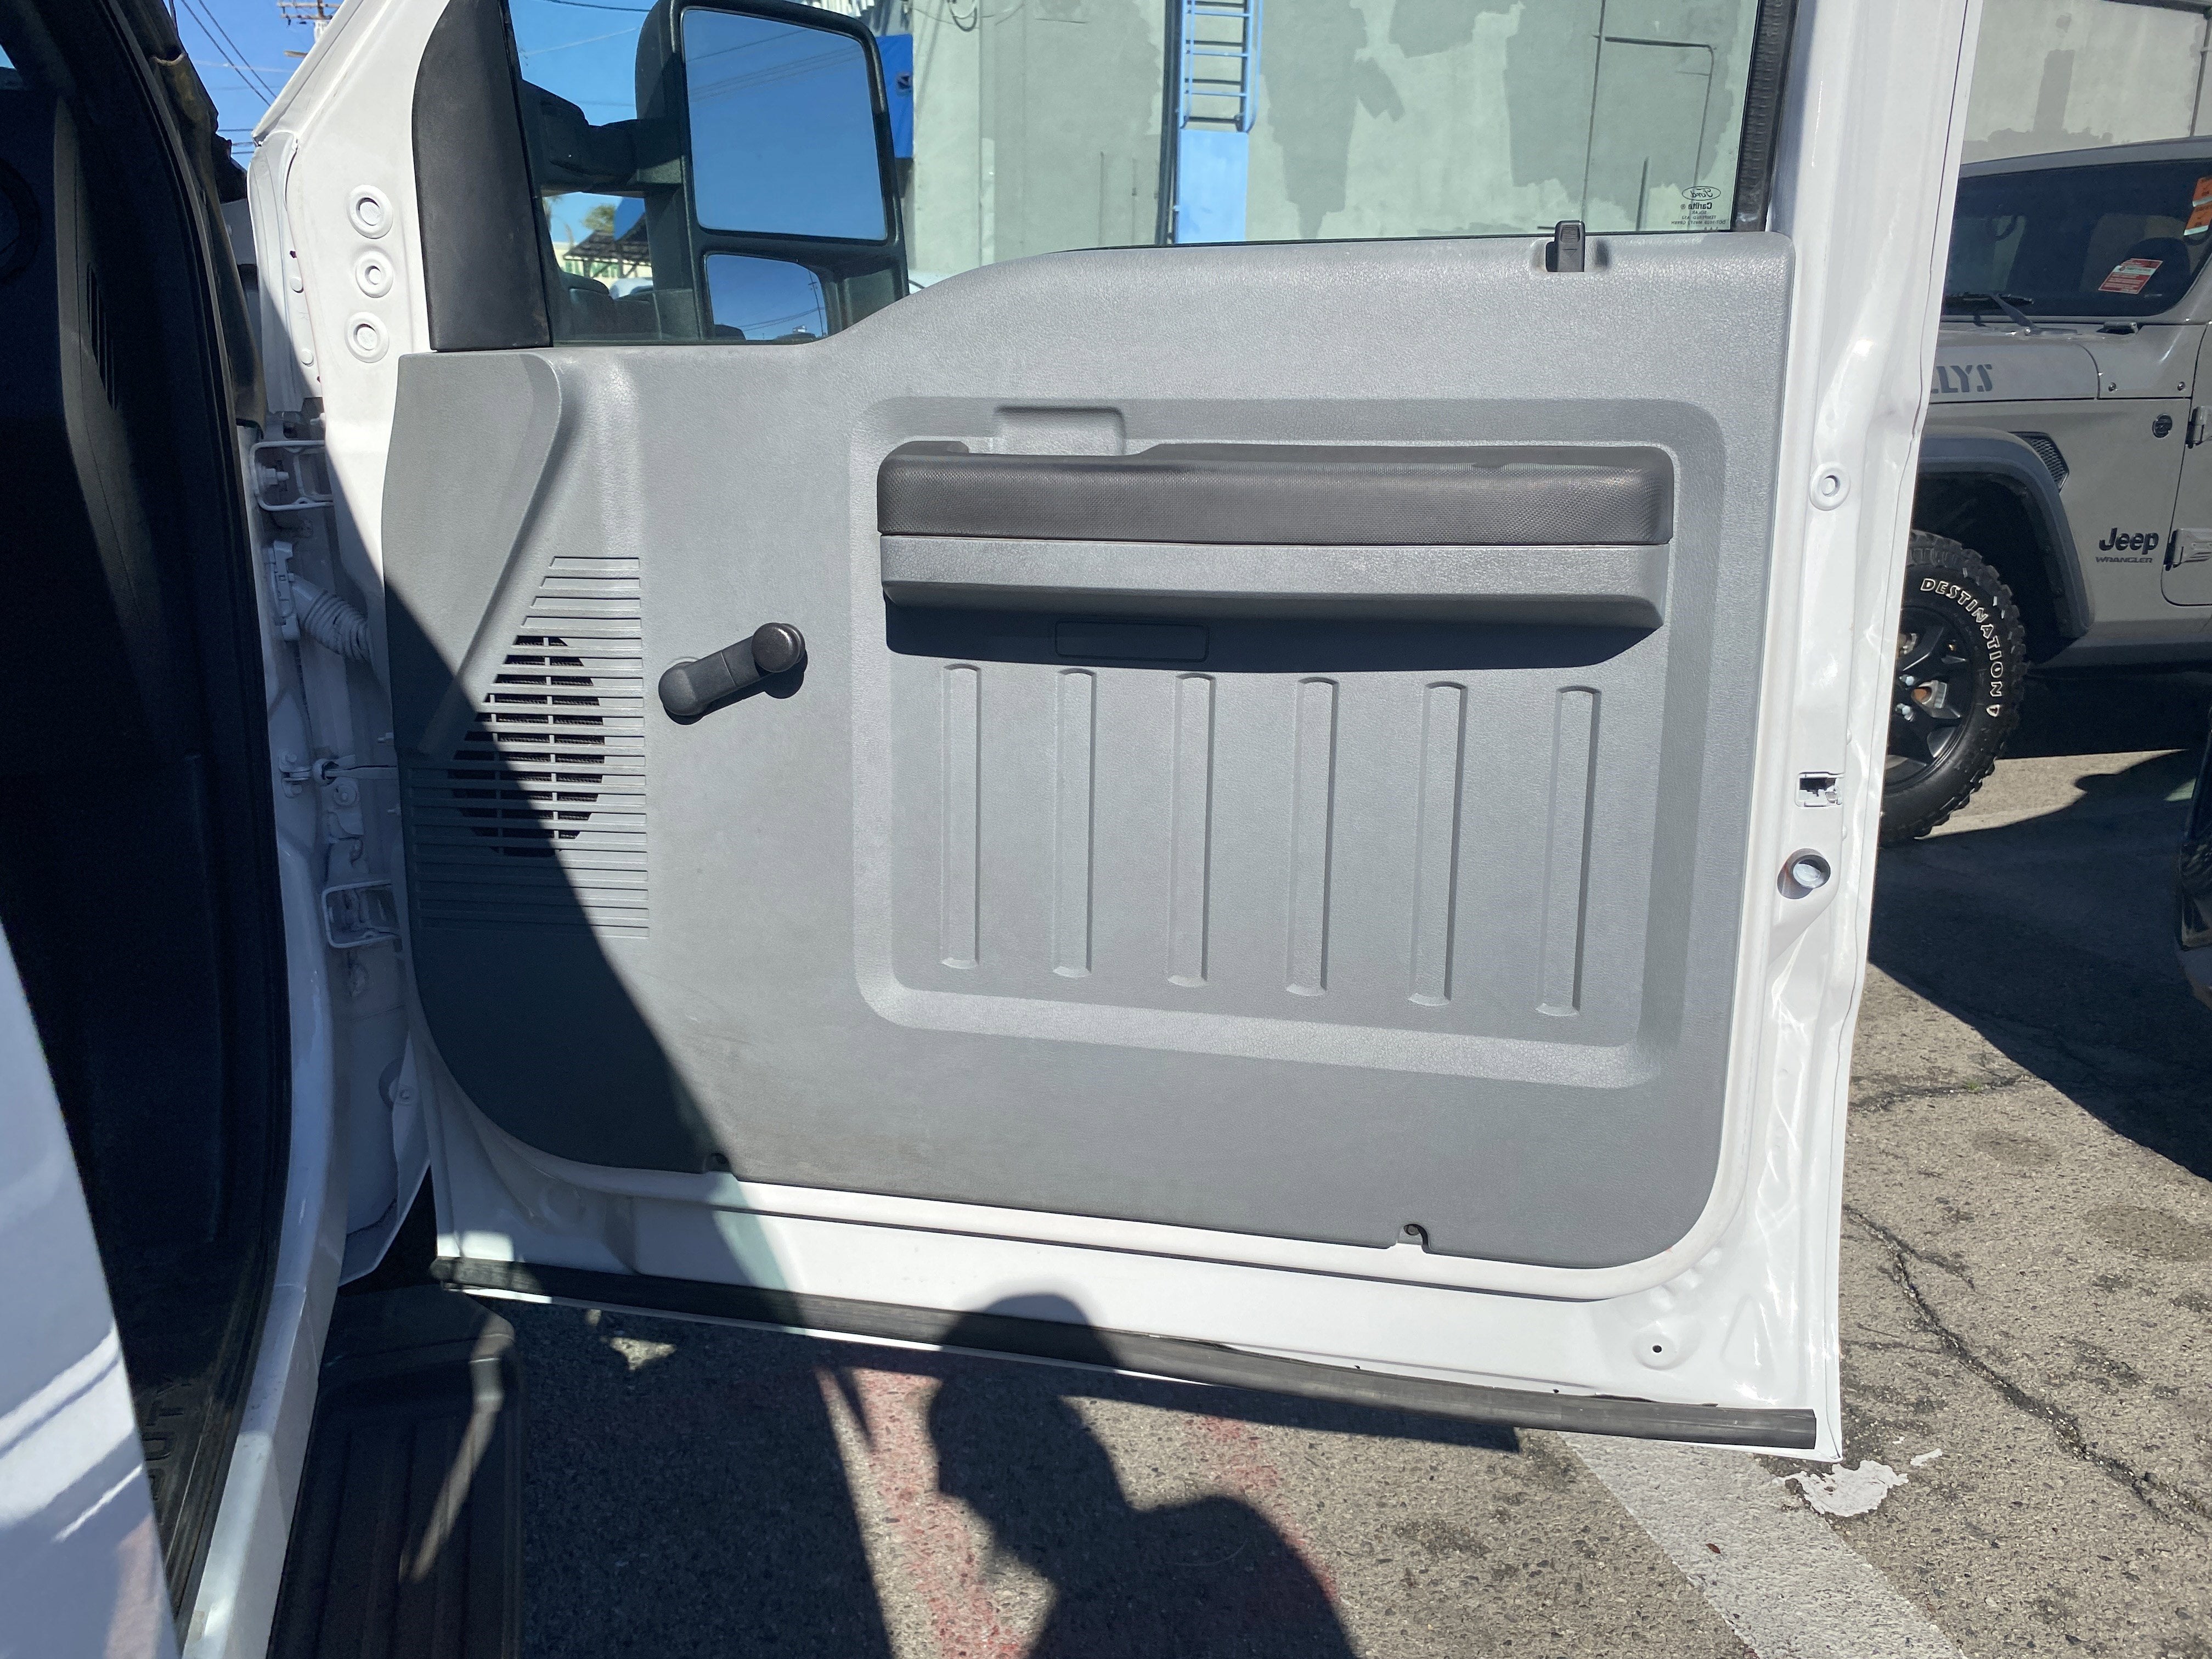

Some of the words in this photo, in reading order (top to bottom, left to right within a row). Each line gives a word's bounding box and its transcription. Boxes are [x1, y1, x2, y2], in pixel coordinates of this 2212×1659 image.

[1931, 364, 1993, 394] LYS
[2099, 527, 2159, 555] Jeep
[1920, 578, 2004, 697] DESTINATION
